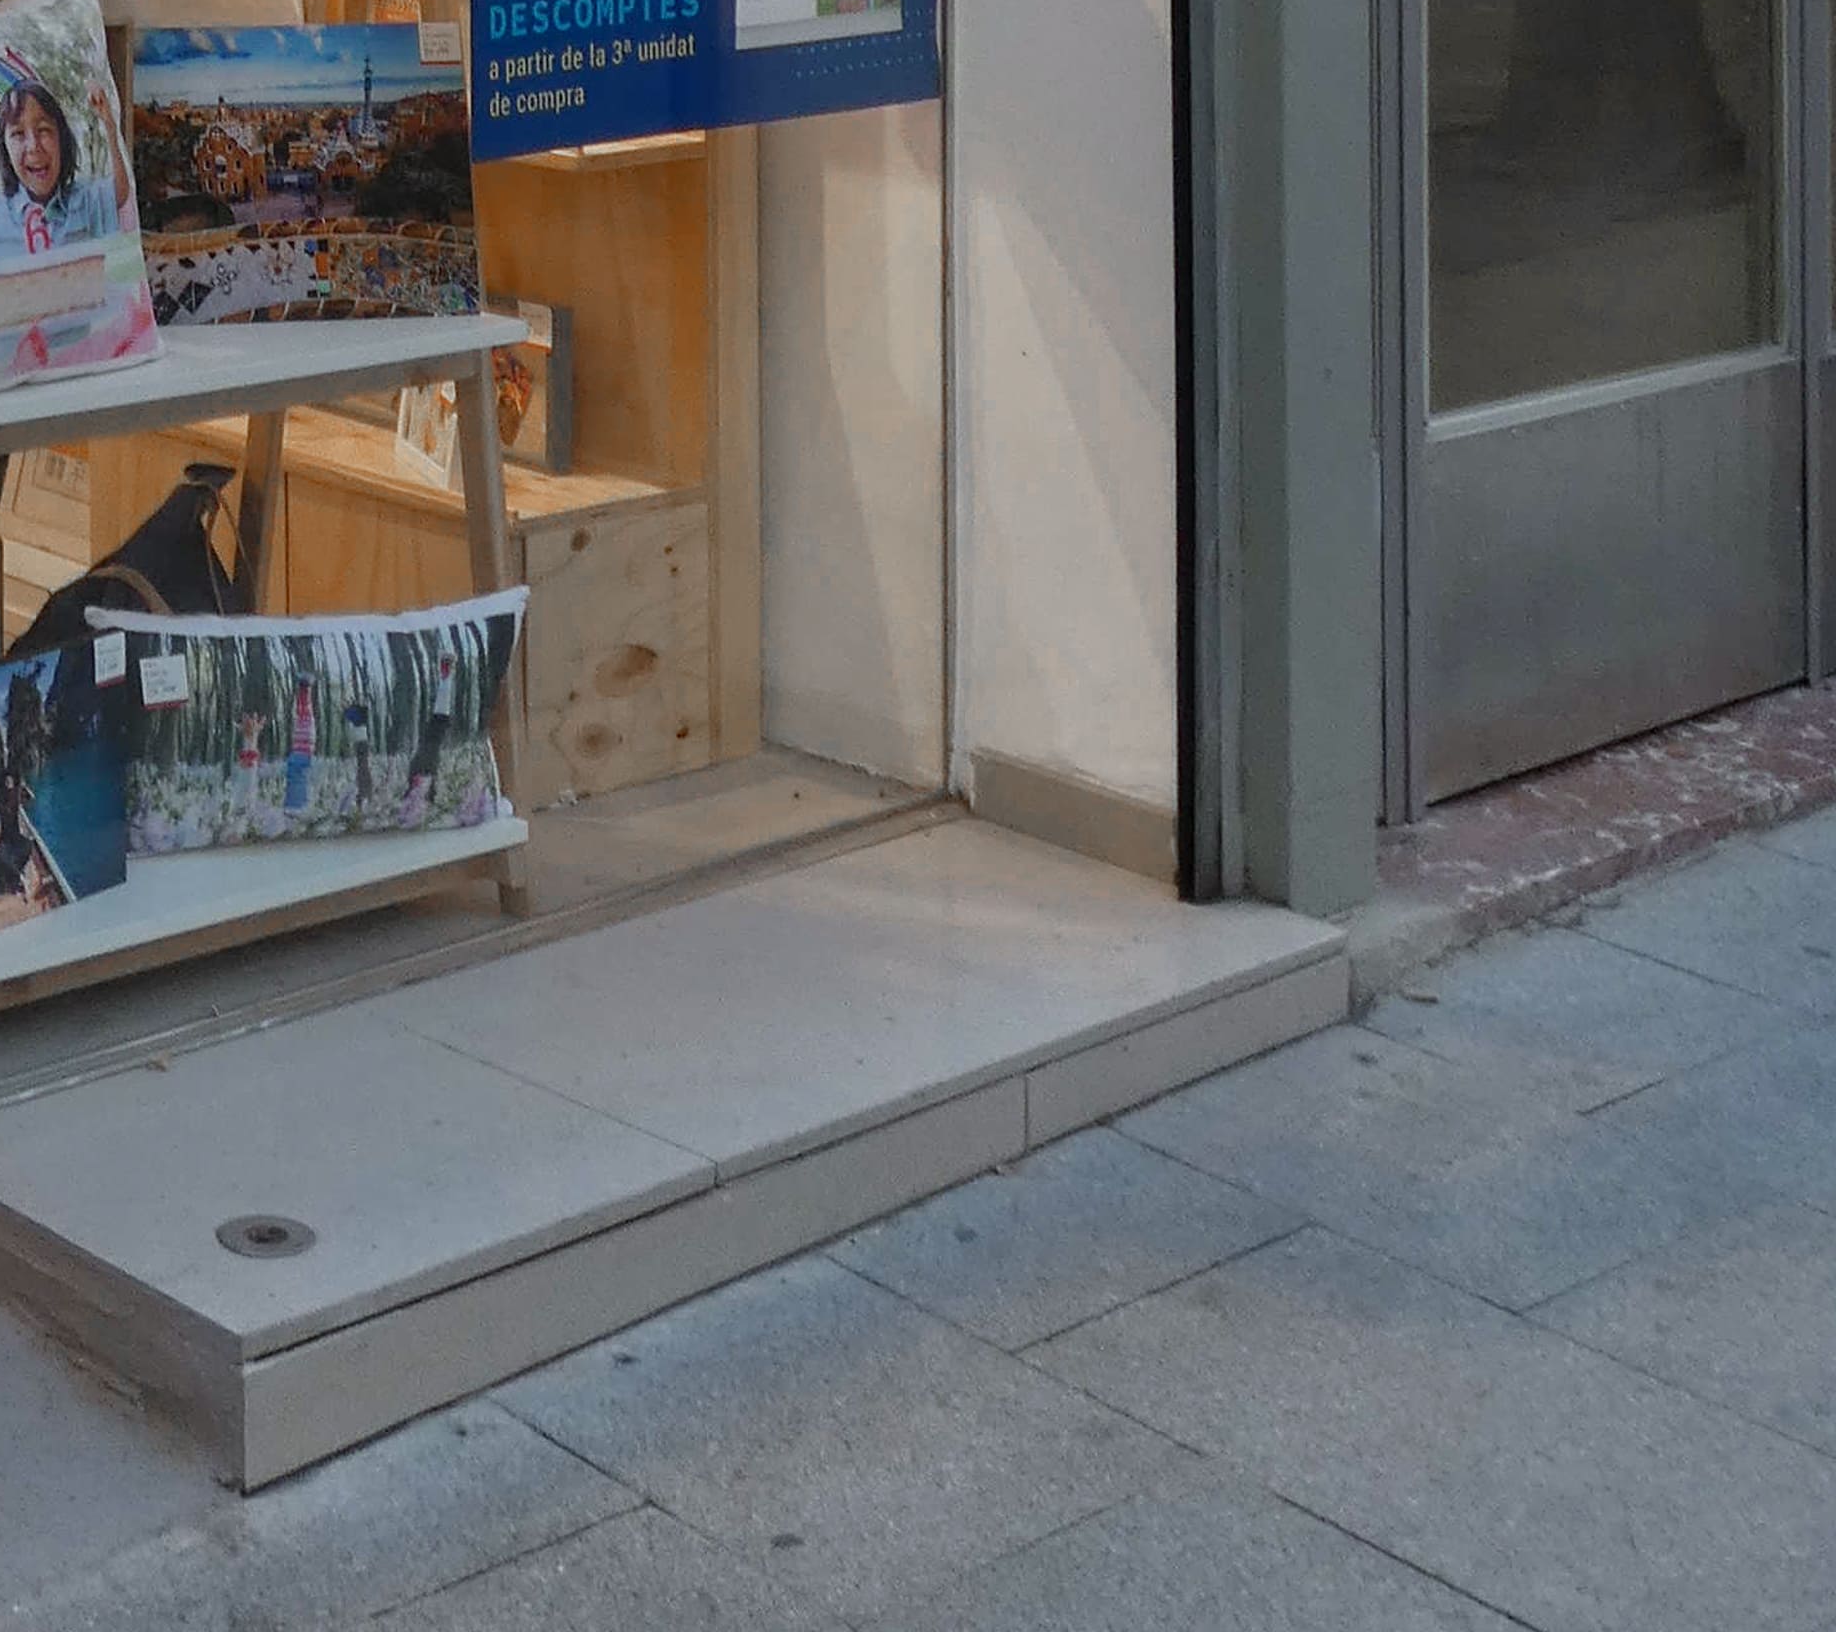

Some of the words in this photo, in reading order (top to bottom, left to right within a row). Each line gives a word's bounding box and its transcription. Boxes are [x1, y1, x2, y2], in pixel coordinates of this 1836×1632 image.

[488, 59, 500, 81] a
[504, 47, 556, 84] partir
[560, 44, 584, 72] de
[588, 42, 606, 69] la
[637, 32, 696, 62] unidat
[488, 90, 511, 118] de
[515, 86, 587, 115] compra
